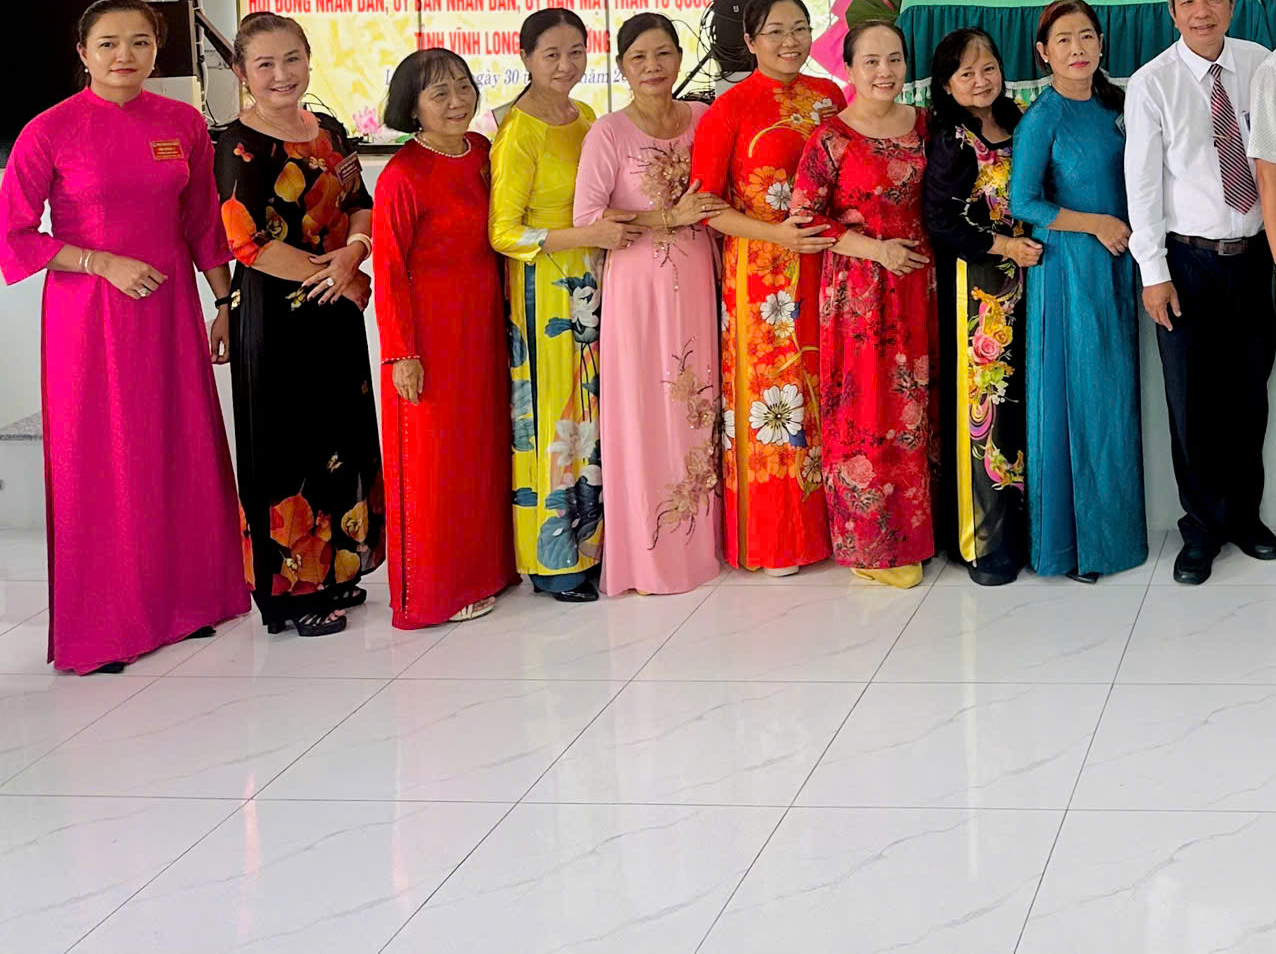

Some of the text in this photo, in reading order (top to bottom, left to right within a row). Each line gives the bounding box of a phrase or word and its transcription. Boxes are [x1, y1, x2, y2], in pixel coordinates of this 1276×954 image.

[448, 27, 480, 54] VĨNH
[485, 31, 521, 54] LONG
[473, 69, 501, 88] gày
[503, 69, 520, 84] 30
